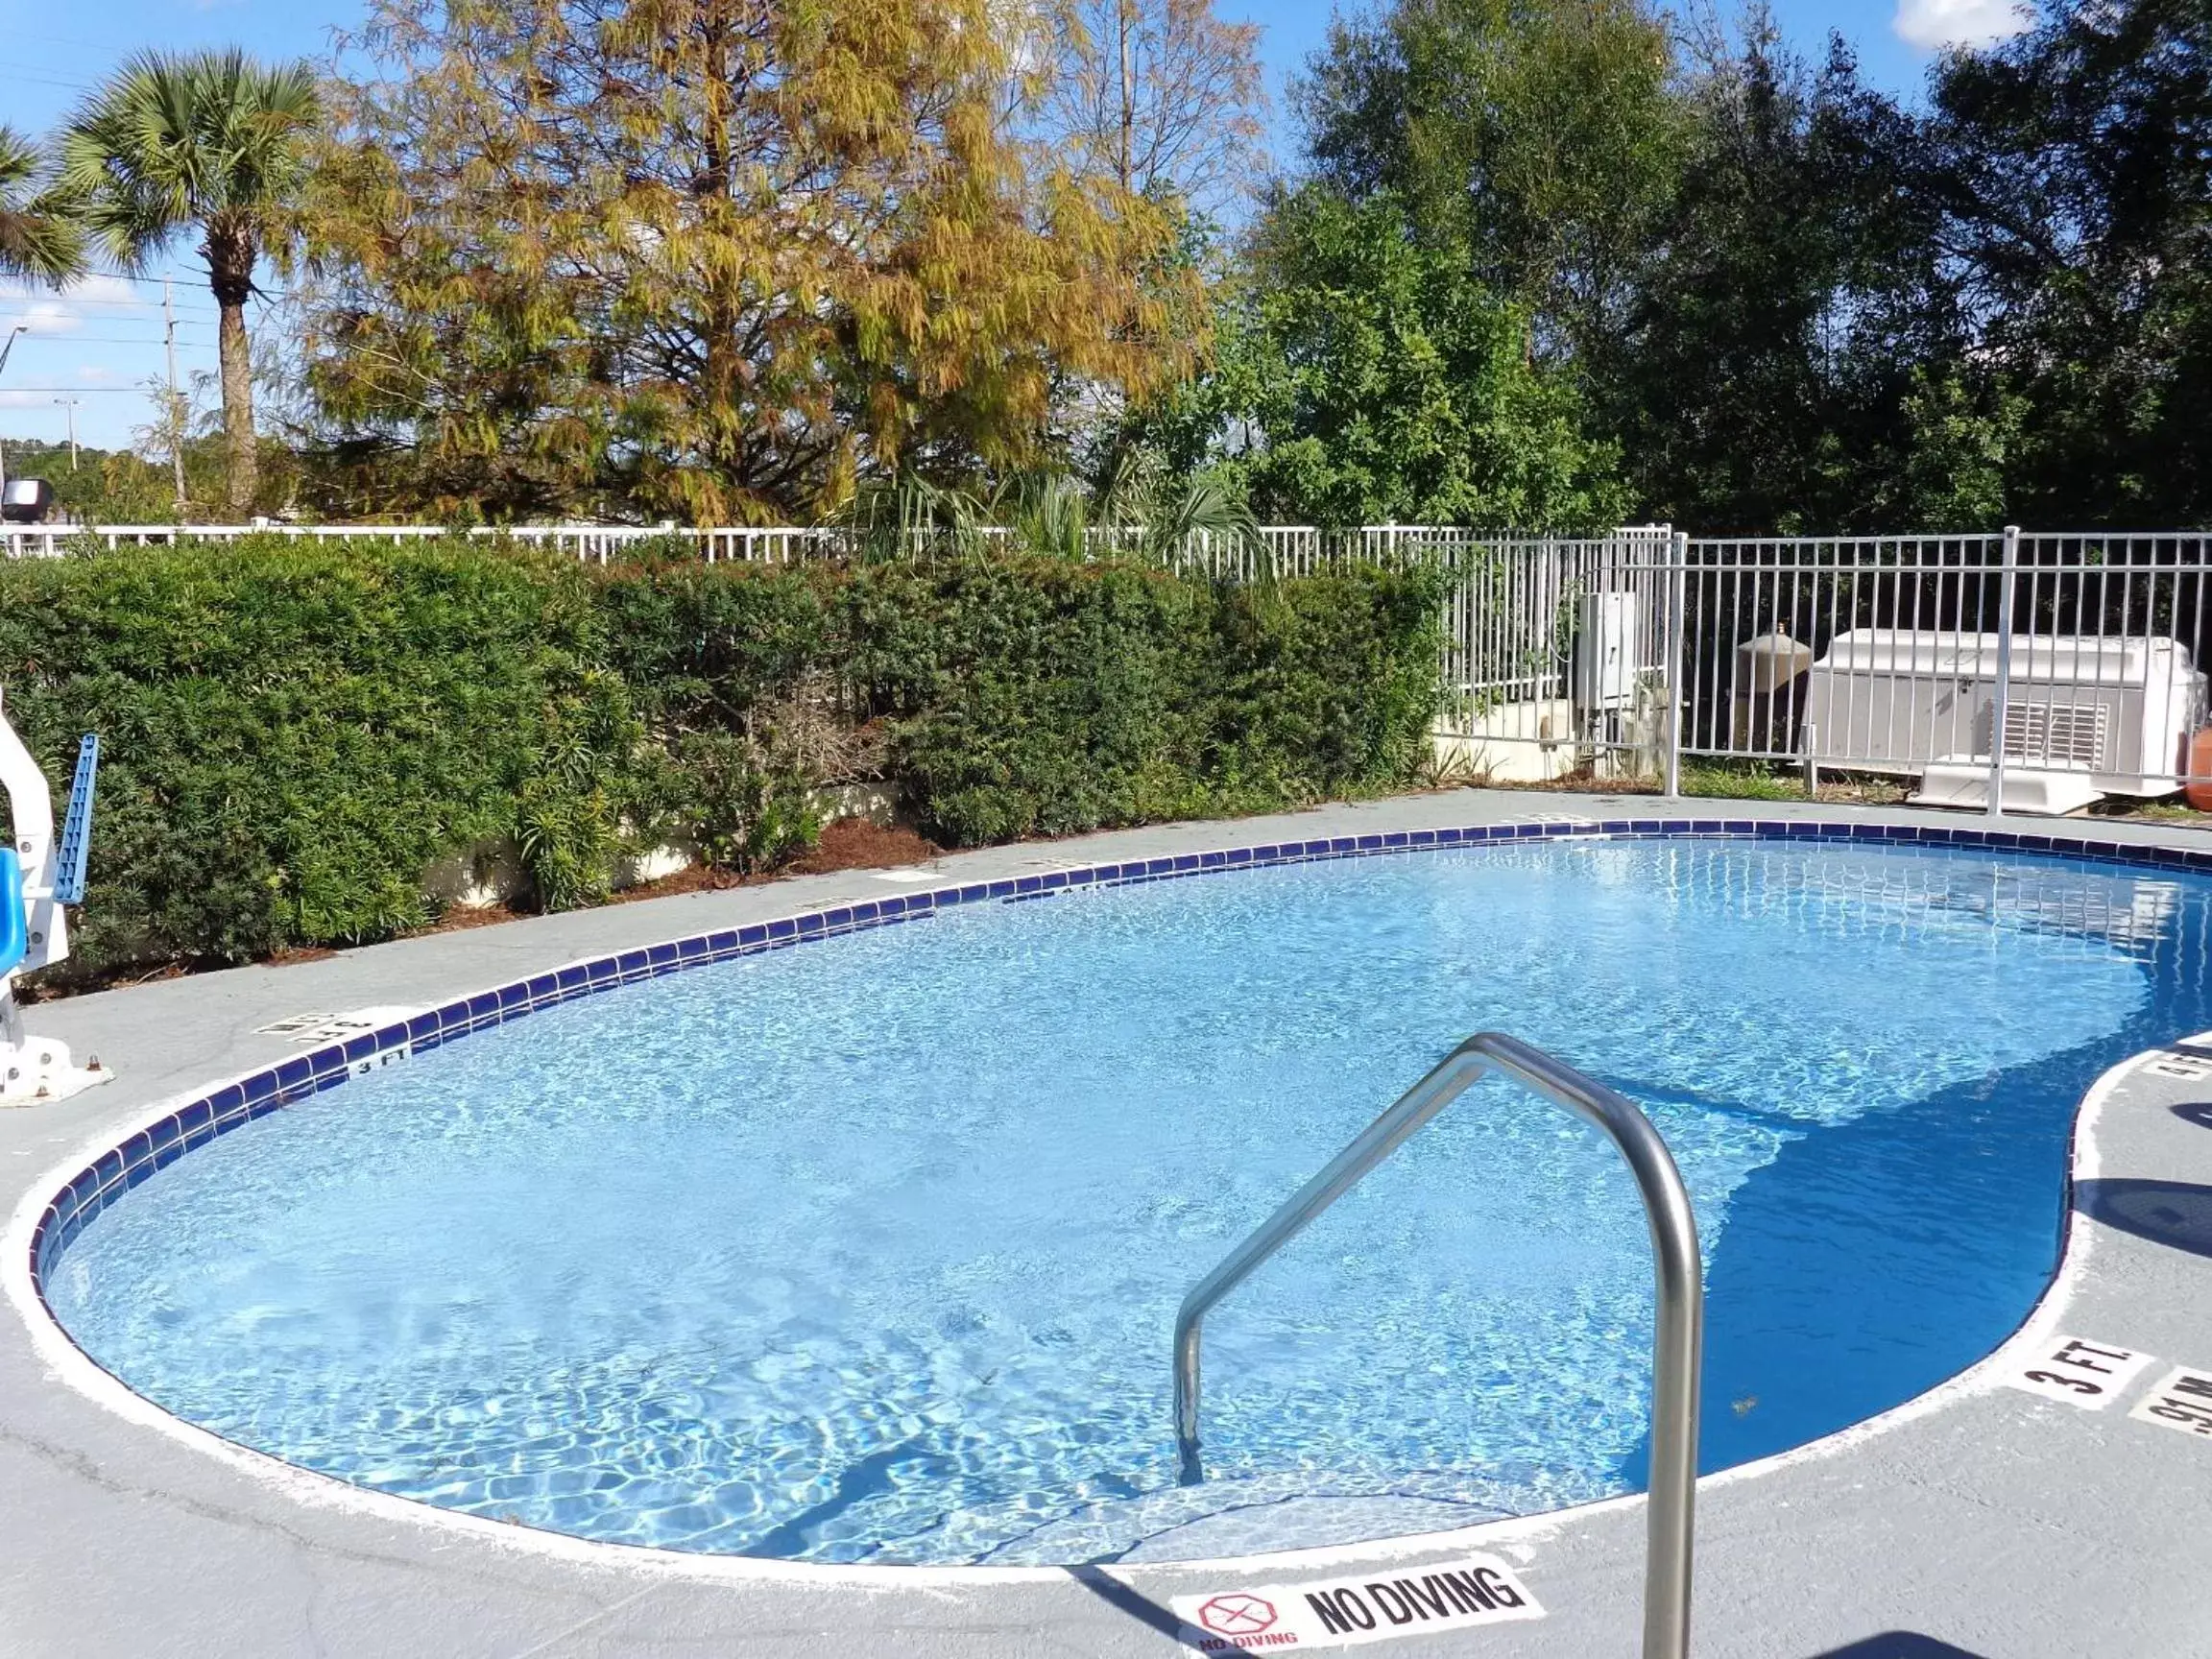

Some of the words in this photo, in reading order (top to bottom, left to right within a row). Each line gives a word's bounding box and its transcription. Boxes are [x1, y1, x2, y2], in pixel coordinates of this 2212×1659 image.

[359, 1063, 372, 1074] 3
[382, 1049, 404, 1066] FT
[2024, 1369, 2104, 1395] 3
[1304, 1587, 1377, 1635] NO
[1363, 1567, 1527, 1625] DIVING
[1199, 1638, 1226, 1651] NO
[1233, 1631, 1299, 1648] DIVING
